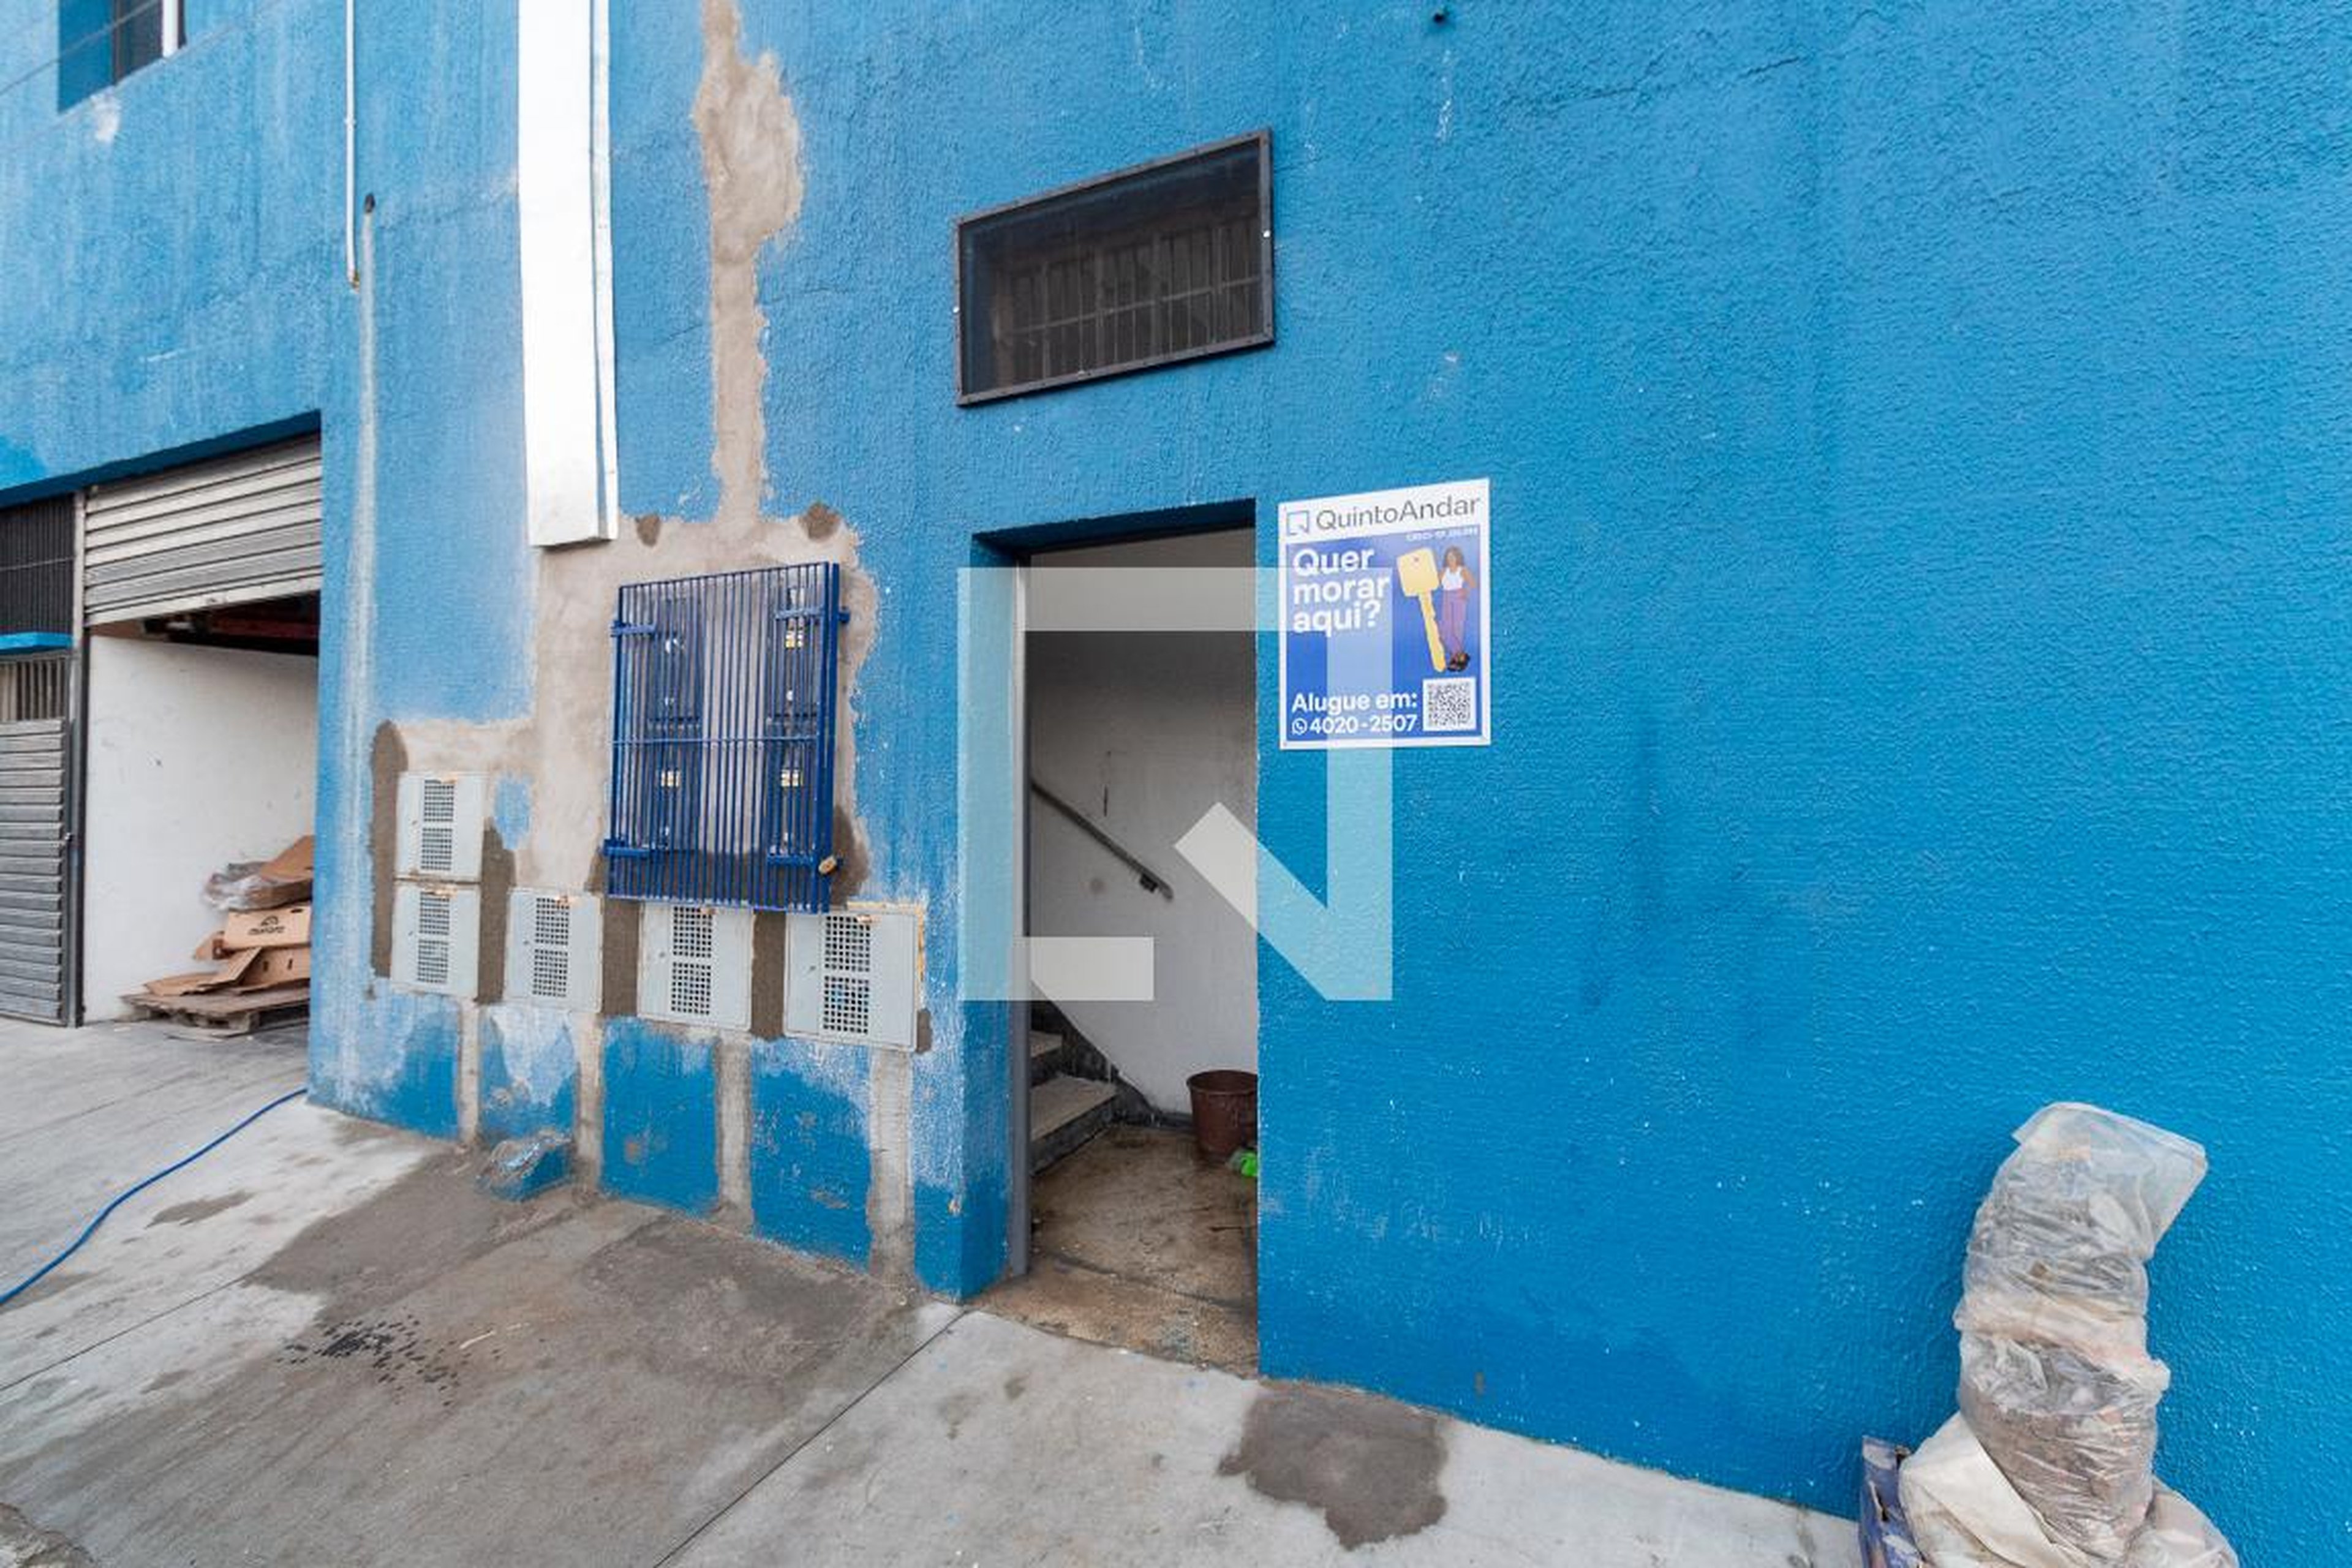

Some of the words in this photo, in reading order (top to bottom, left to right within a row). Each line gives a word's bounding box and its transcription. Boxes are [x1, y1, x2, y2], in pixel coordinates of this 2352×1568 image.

[1316, 496, 1480, 530] QuintoAndar
[1293, 549, 1374, 576] Quer
[1294, 576, 1390, 605] morar
[1294, 600, 1381, 637] aqui?
[1292, 692, 1371, 715] Alugue
[1375, 692, 1417, 709] em:
